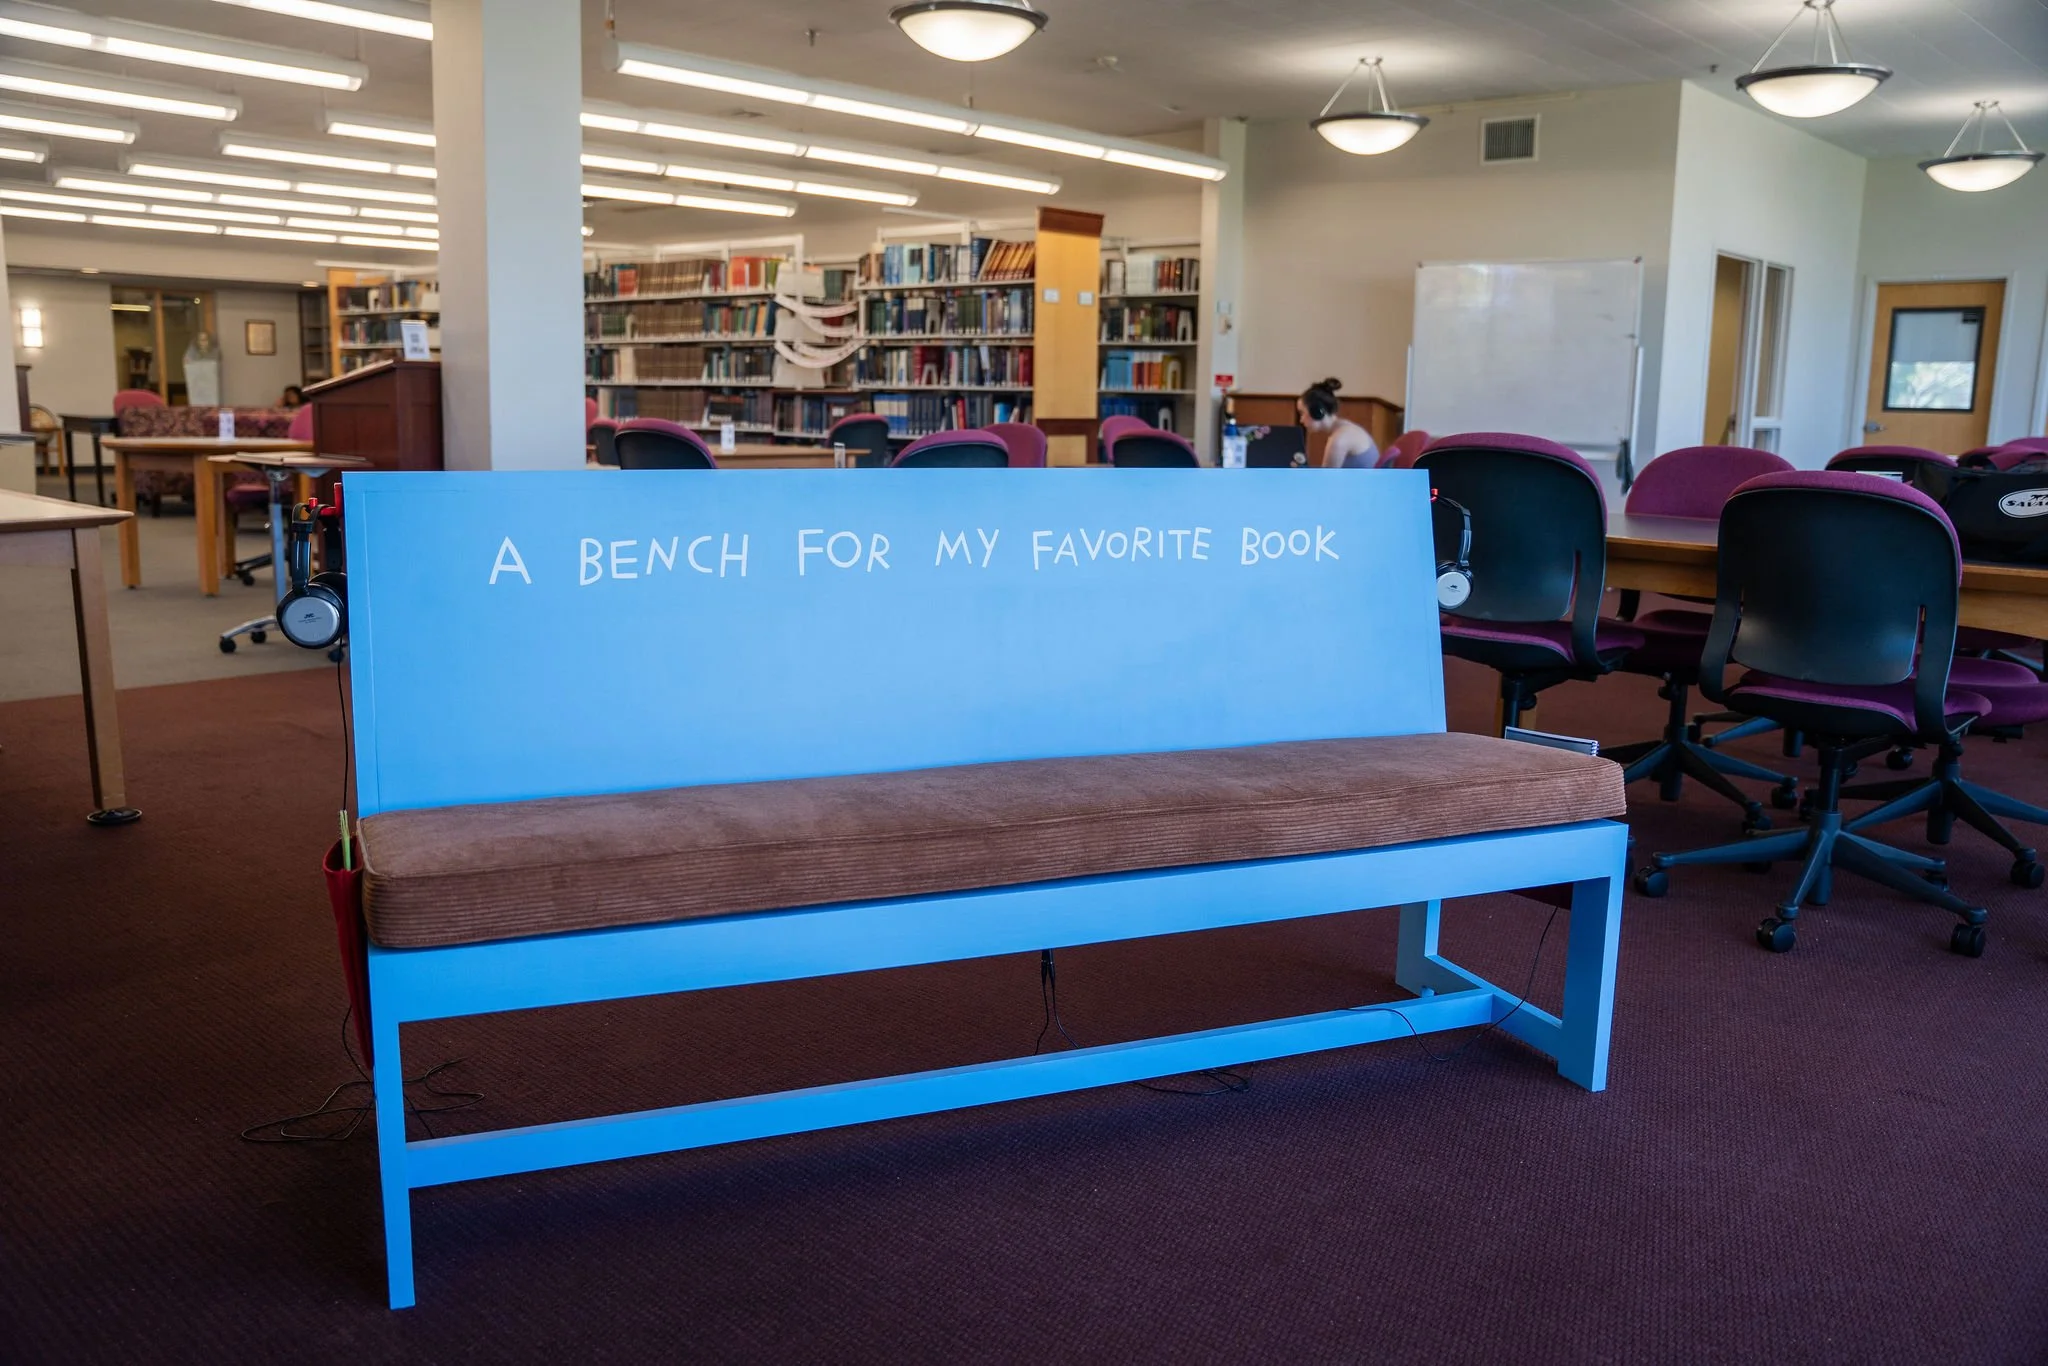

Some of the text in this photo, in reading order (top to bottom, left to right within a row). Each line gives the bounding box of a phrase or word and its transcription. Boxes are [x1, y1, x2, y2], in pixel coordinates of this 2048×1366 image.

[488, 525, 1340, 586] A BENCH FOR MY FAVORITE BOOK
